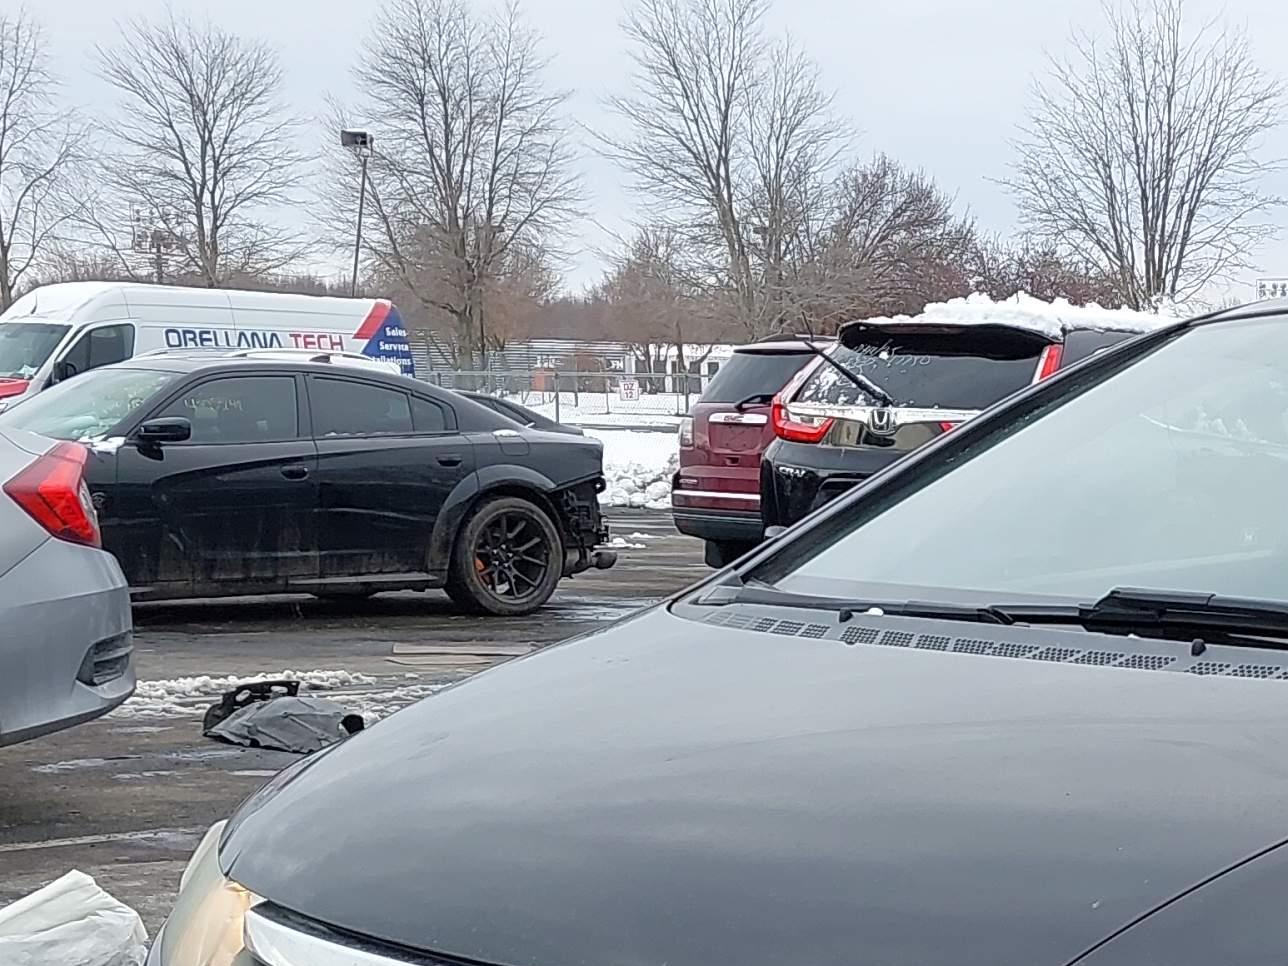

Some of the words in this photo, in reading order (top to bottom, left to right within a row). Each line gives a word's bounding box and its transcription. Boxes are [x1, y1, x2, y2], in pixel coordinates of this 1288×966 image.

[385, 326, 407, 337] Sales
[165, 328, 283, 349] ORELLANA
[289, 333, 344, 351] TECH
[371, 355, 412, 366] tallations
[624, 391, 635, 399] 12
